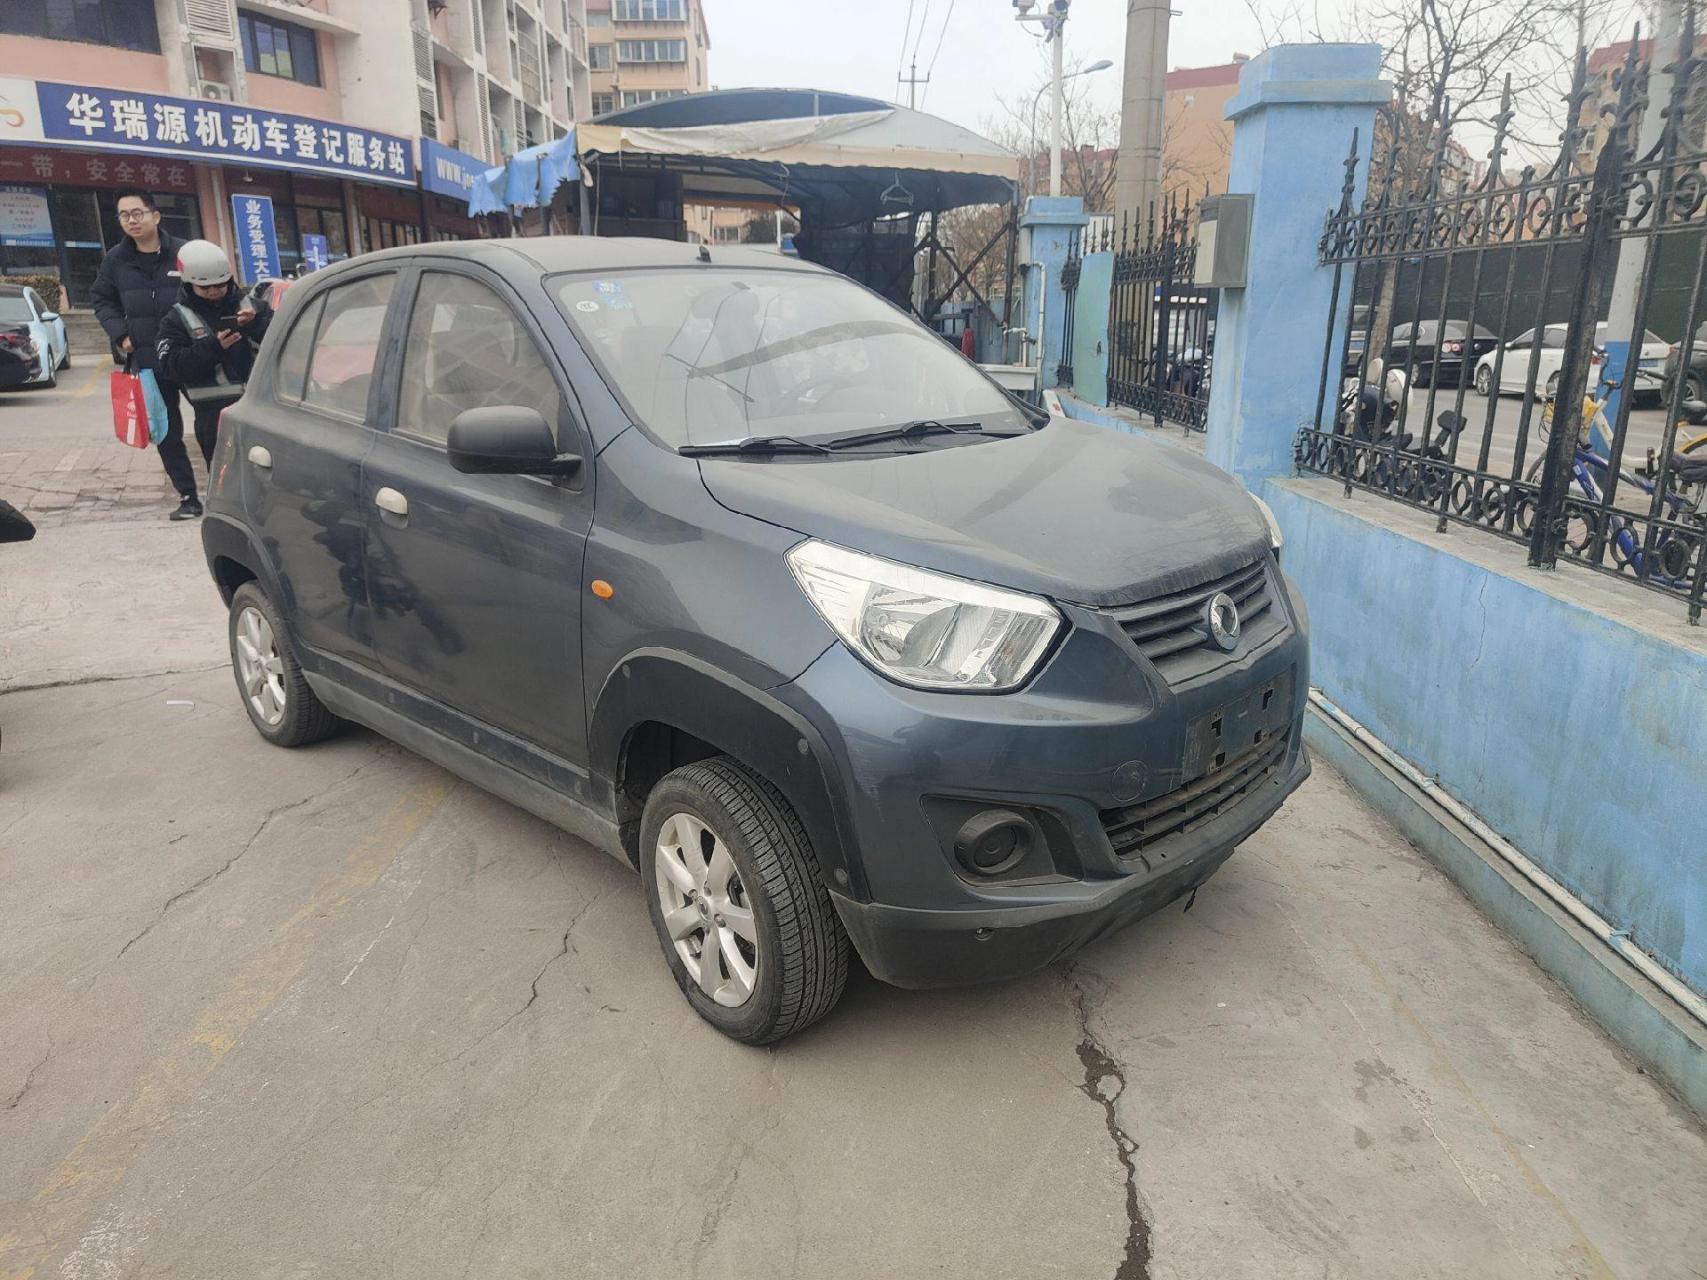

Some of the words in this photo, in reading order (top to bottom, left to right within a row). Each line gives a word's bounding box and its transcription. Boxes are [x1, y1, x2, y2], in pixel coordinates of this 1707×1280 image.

[65, 92, 406, 176] 华瑞源机动车登记服务站
